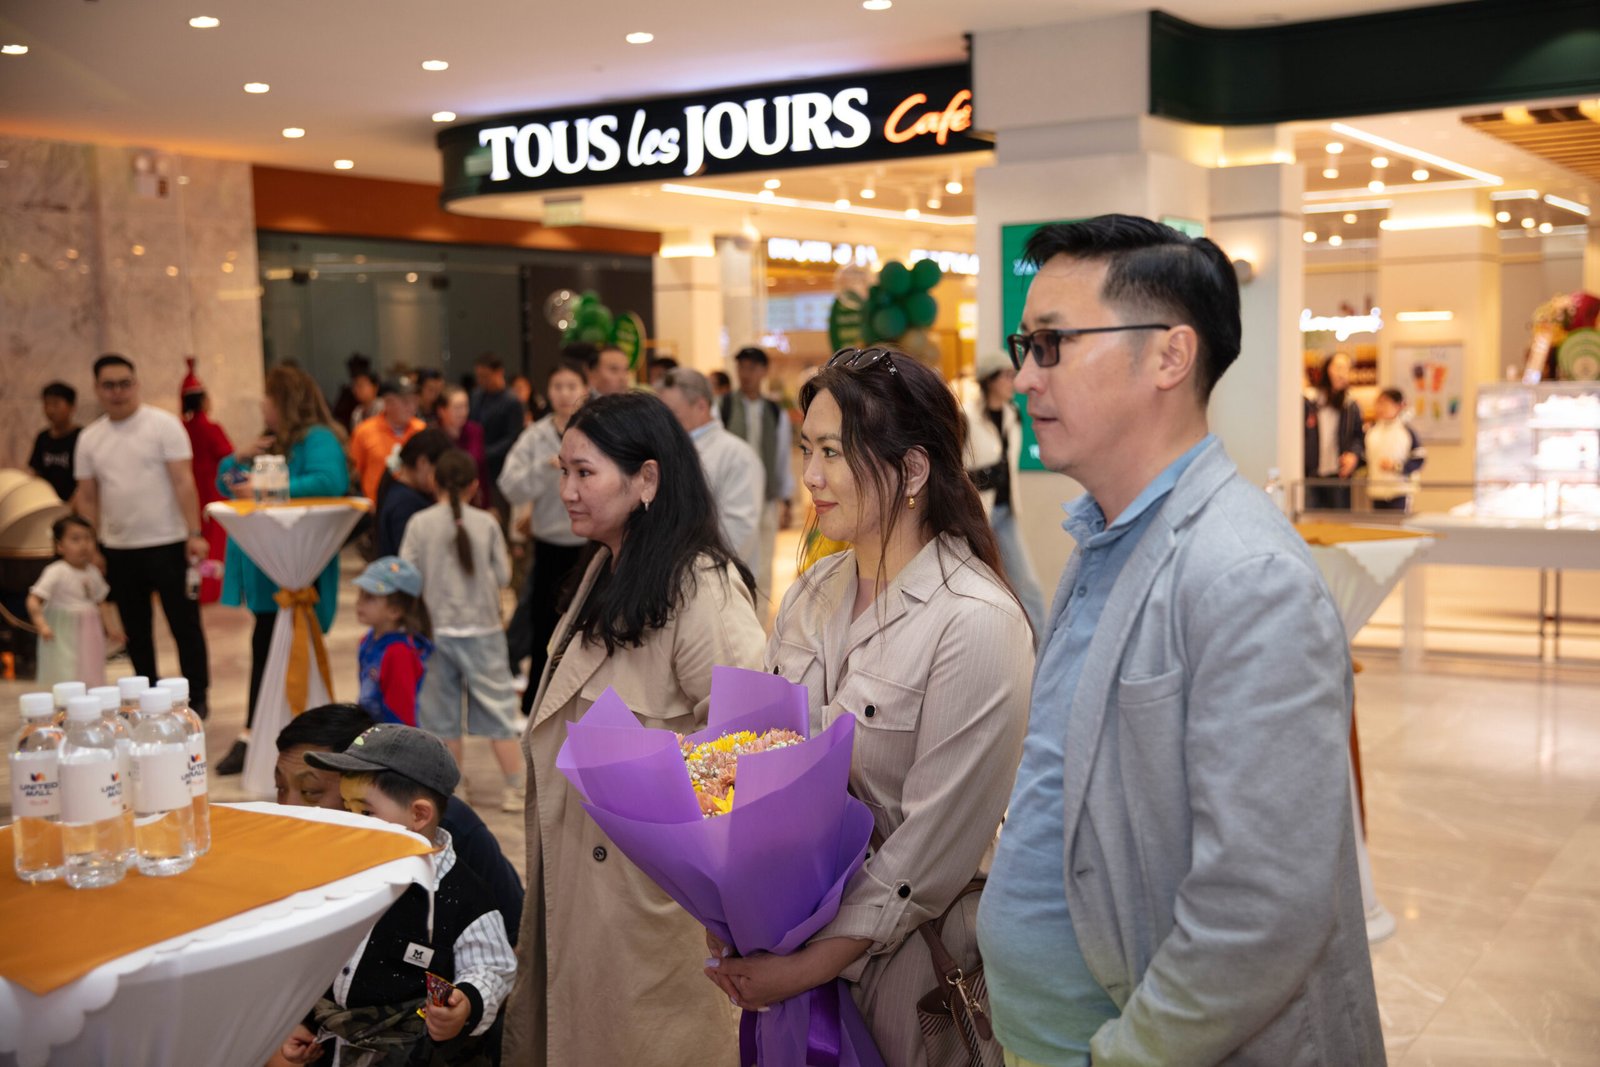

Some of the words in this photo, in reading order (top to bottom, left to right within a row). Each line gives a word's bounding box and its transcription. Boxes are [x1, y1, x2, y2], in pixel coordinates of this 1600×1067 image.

[479, 114, 621, 181] TOUS
[627, 109, 680, 166] les
[684, 87, 872, 176] JOURS
[19, 782, 59, 791] UNITED
[25, 789, 53, 797] MALL
